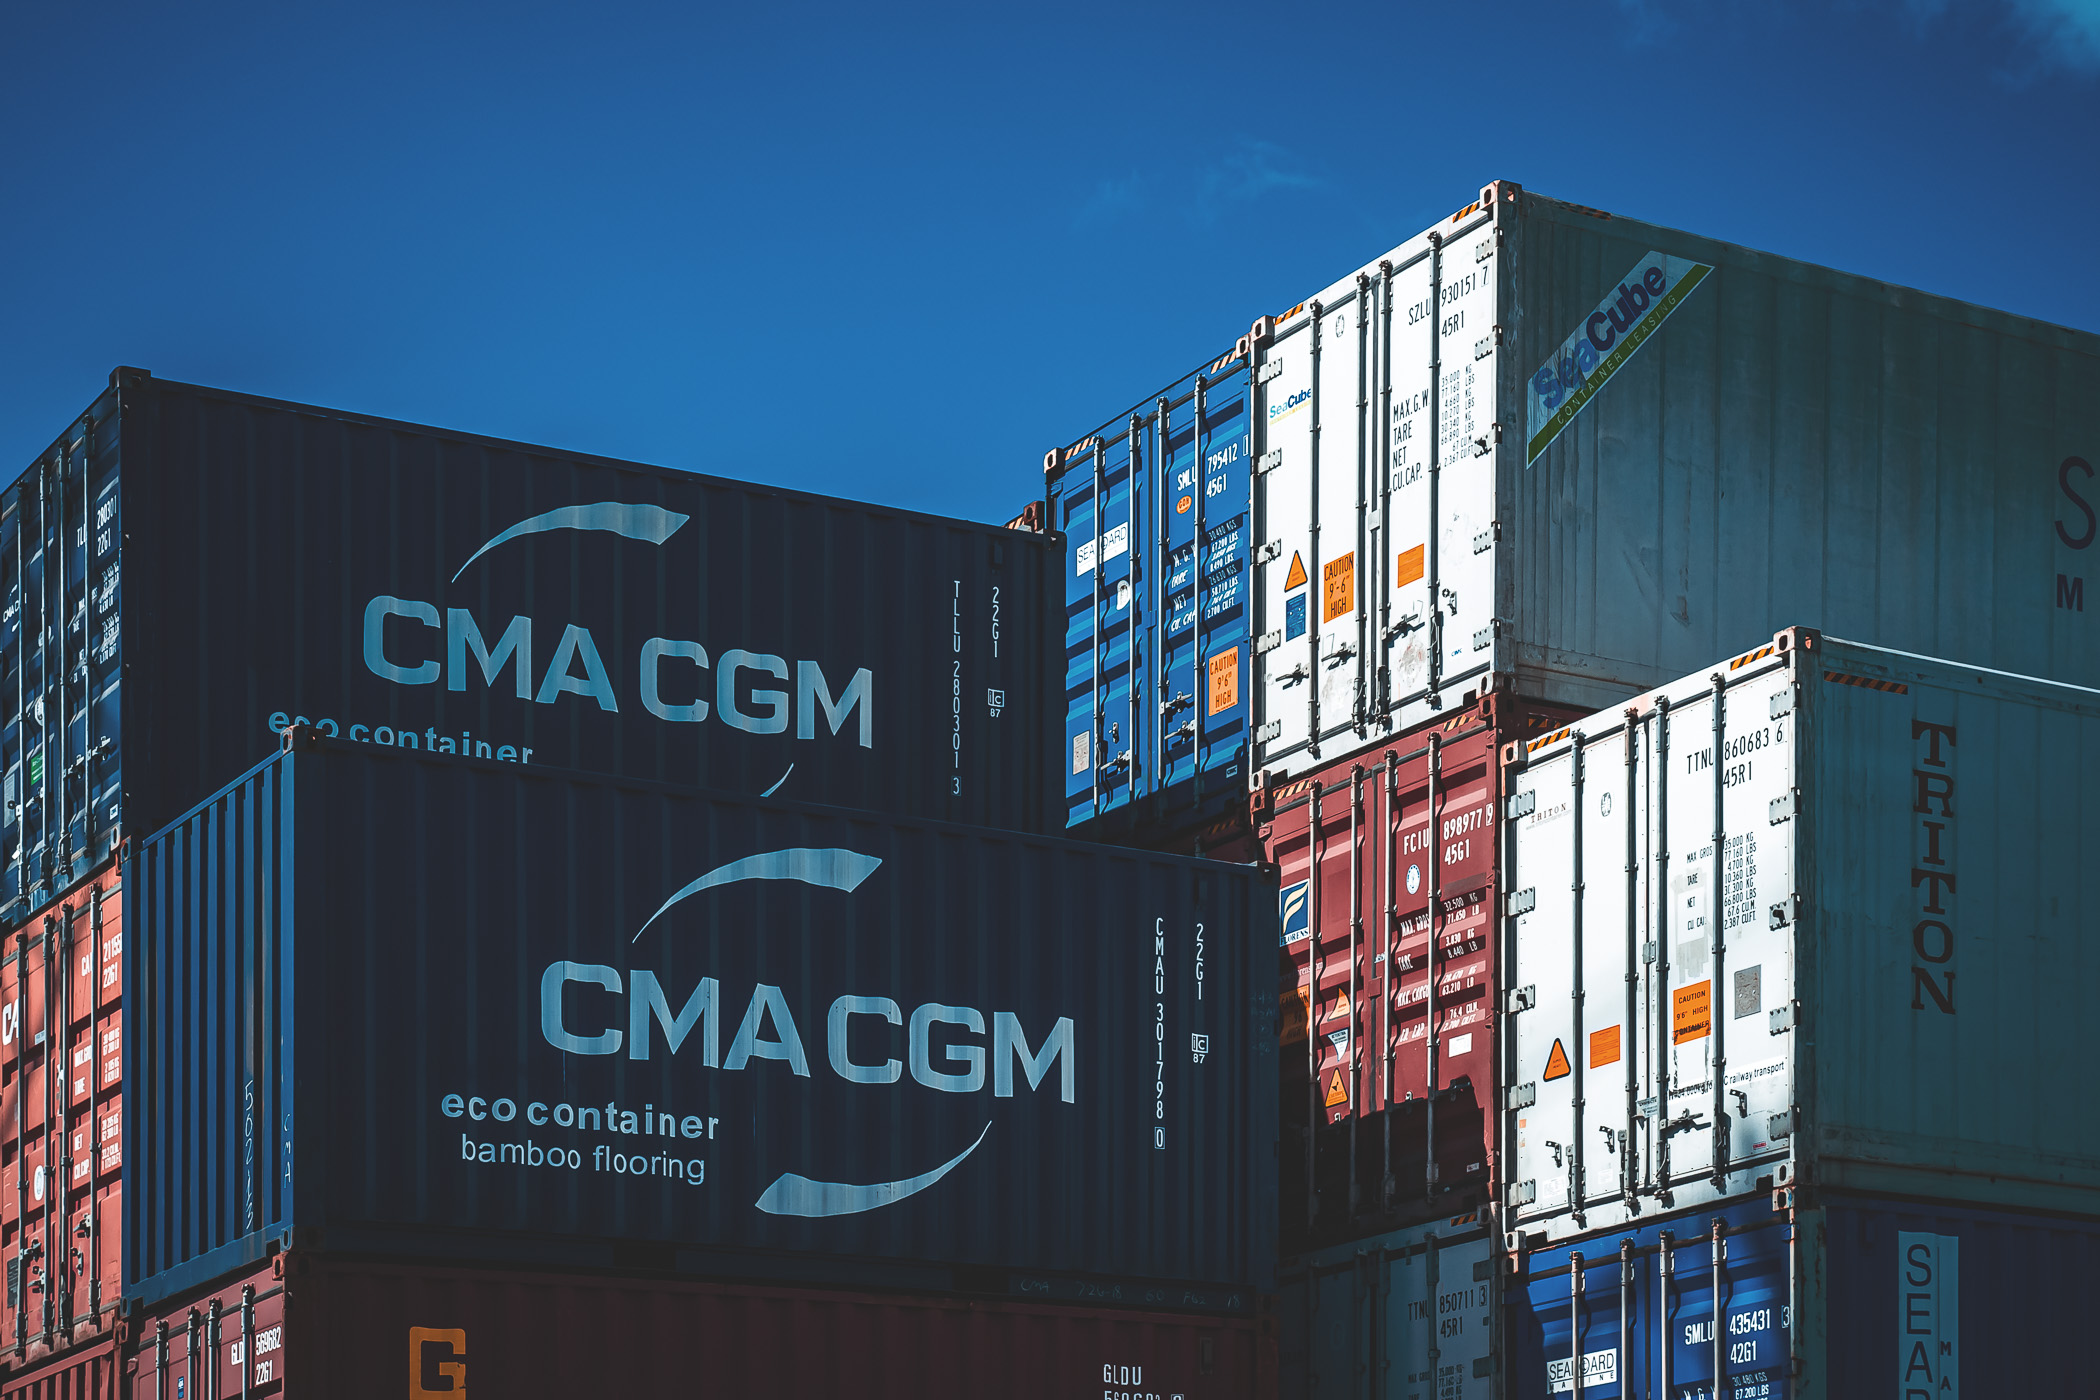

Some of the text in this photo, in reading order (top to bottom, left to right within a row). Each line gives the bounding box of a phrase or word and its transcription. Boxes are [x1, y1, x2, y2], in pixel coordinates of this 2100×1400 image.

[1408, 264, 1490, 326] SZLU 930151 7
[1442, 310, 1464, 338] 45R1
[1533, 266, 1666, 410] SeaCube
[1557, 294, 1677, 425] CONTAINER LEASING
[1270, 388, 1312, 418] SeaCube
[1393, 420, 1412, 446] TARE
[1208, 442, 1238, 474] 795412
[1392, 446, 1407, 470] NET
[1206, 473, 1226, 498] 45G1
[96, 495, 117, 530] 280301
[2054, 456, 2097, 550] S
[1171, 570, 1189, 588] TARE
[1324, 553, 1354, 582] CAUTION
[1172, 594, 1187, 612] NET
[2056, 574, 2084, 612] M
[1330, 596, 1346, 618] HIGH
[364, 594, 873, 749] CMA CGM
[1209, 651, 1238, 676] CAUTION
[1216, 690, 1232, 708] HIGH
[952, 660, 960, 768] 280301
[990, 708, 1000, 718] 87
[350, 724, 533, 764] container
[1724, 728, 1769, 761] 860683
[951, 776, 962, 796] 3
[1722, 760, 1752, 788] 45R1
[1530, 802, 1567, 824] TRITON
[1404, 828, 1430, 856] FCIU
[1444, 808, 1482, 840] 898977
[1486, 803, 1494, 826] 9
[1746, 832, 1754, 842] KG
[1444, 838, 1470, 866] 45G1
[1686, 846, 1712, 864] MAX GROS
[1746, 842, 1756, 854] LBS
[1746, 854, 1754, 866] KG
[1687, 872, 1698, 886] TARE
[1746, 864, 1756, 878] LBS
[1910, 719, 1958, 1015] TRITON
[1746, 878, 1754, 888] KG
[1746, 888, 1756, 900] LBS
[1444, 892, 1478, 912] 32.500 KG
[1472, 904, 1480, 916] LB
[1687, 896, 1696, 908] NET
[1280, 930, 1309, 946] FLORENS
[1469, 940, 1478, 952] LB
[1155, 917, 1164, 994] CMAU
[1196, 922, 1204, 1000] 22G1
[1398, 954, 1414, 972] TARE
[1442, 976, 1475, 996] 63.210 LB
[1678, 990, 1706, 1004] CAUTION
[1450, 1005, 1462, 1018] 76.4
[1692, 1004, 1708, 1016] HIGH
[540, 960, 1076, 1104] CMA CGM
[1156, 1002, 1164, 1120] 301798
[1192, 1053, 1205, 1064] 87
[1754, 1061, 1784, 1078] transport
[441, 1093, 719, 1140] eco container
[462, 1134, 705, 1186] bamboo flooring
[1440, 1289, 1474, 1314] 850711
[1479, 1285, 1488, 1307] 3
[1440, 1316, 1462, 1338] 45R1
[1685, 1305, 1790, 1346] SMLU 435431 3
[1904, 1244, 1933, 1400] SEA
[231, 1326, 282, 1366] GLD 569682
[1730, 1340, 1756, 1364] 42G1
[409, 1326, 466, 1400] G
[1103, 1363, 1142, 1386] GLDU
[1549, 1352, 1614, 1380] SEAOARD
[1550, 1372, 1614, 1391] MAINE
[1758, 1384, 1770, 1396] LBS
